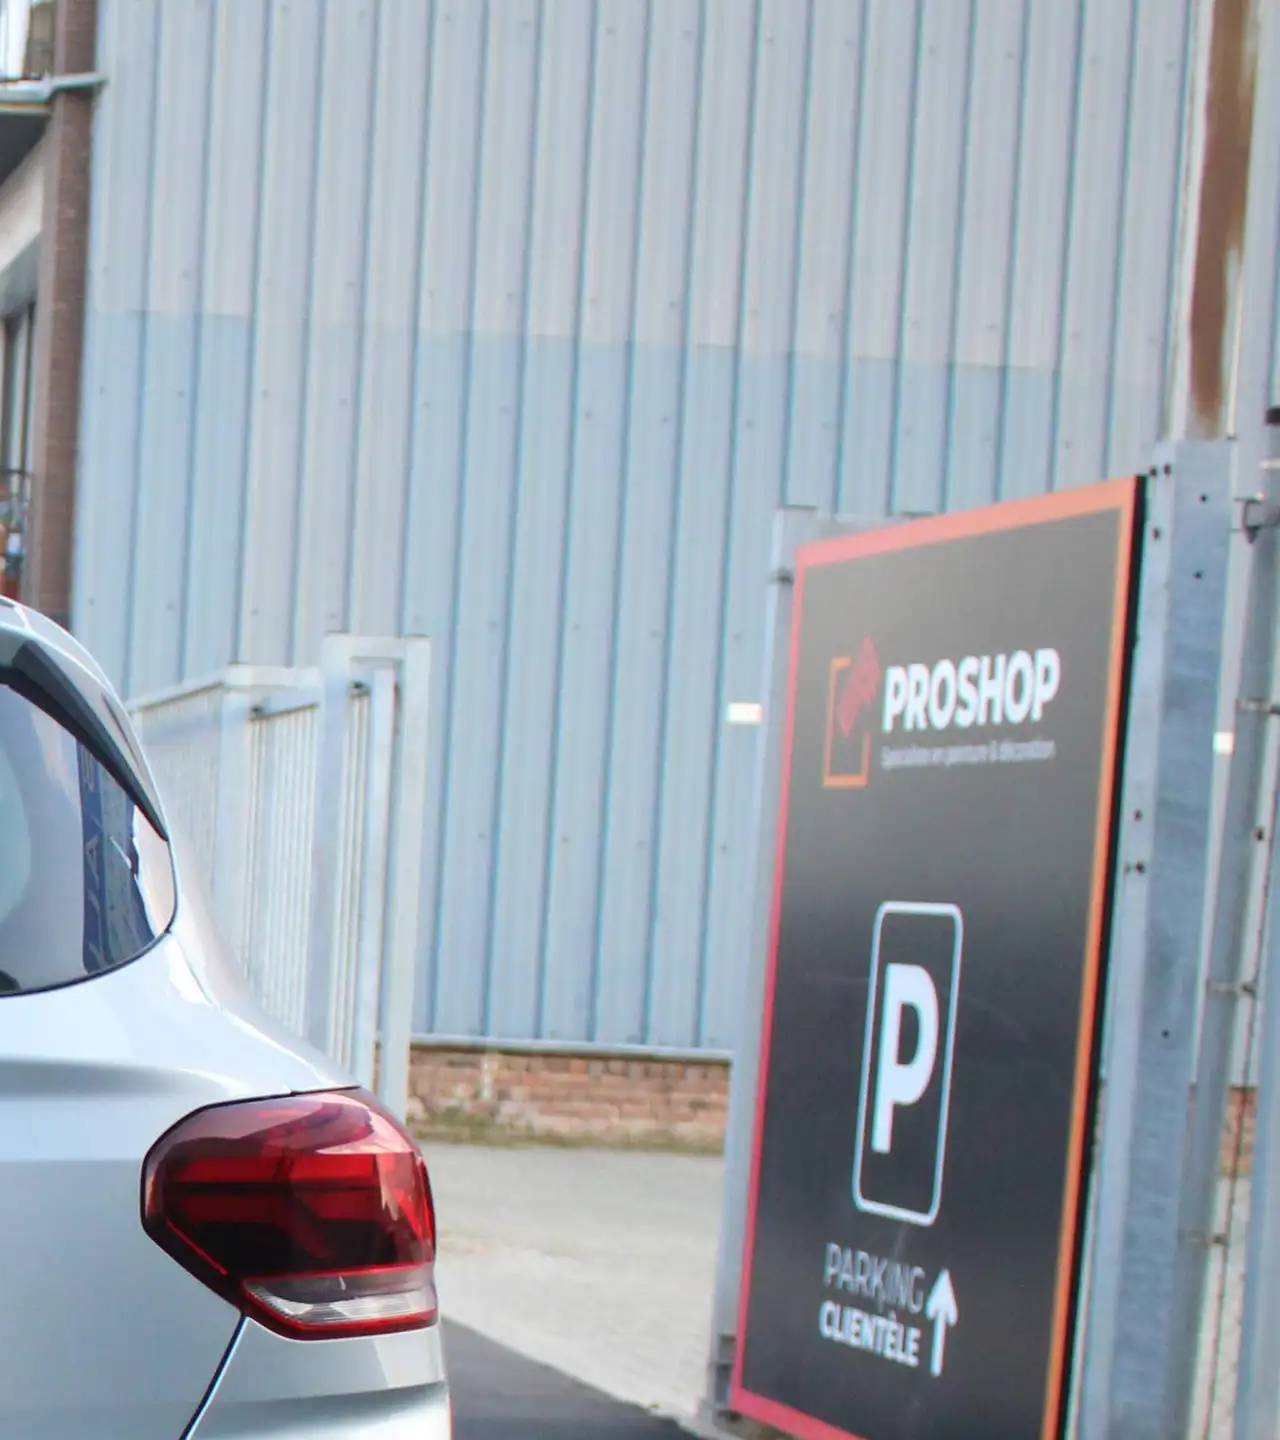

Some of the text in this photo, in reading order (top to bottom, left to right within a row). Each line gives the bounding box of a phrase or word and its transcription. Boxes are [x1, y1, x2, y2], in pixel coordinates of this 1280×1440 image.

[882, 648, 1061, 733] PROSHOP
[871, 963, 939, 1153] P
[823, 1242, 926, 1315] PARKING
[819, 1299, 922, 1368] CLIENTÈLE
